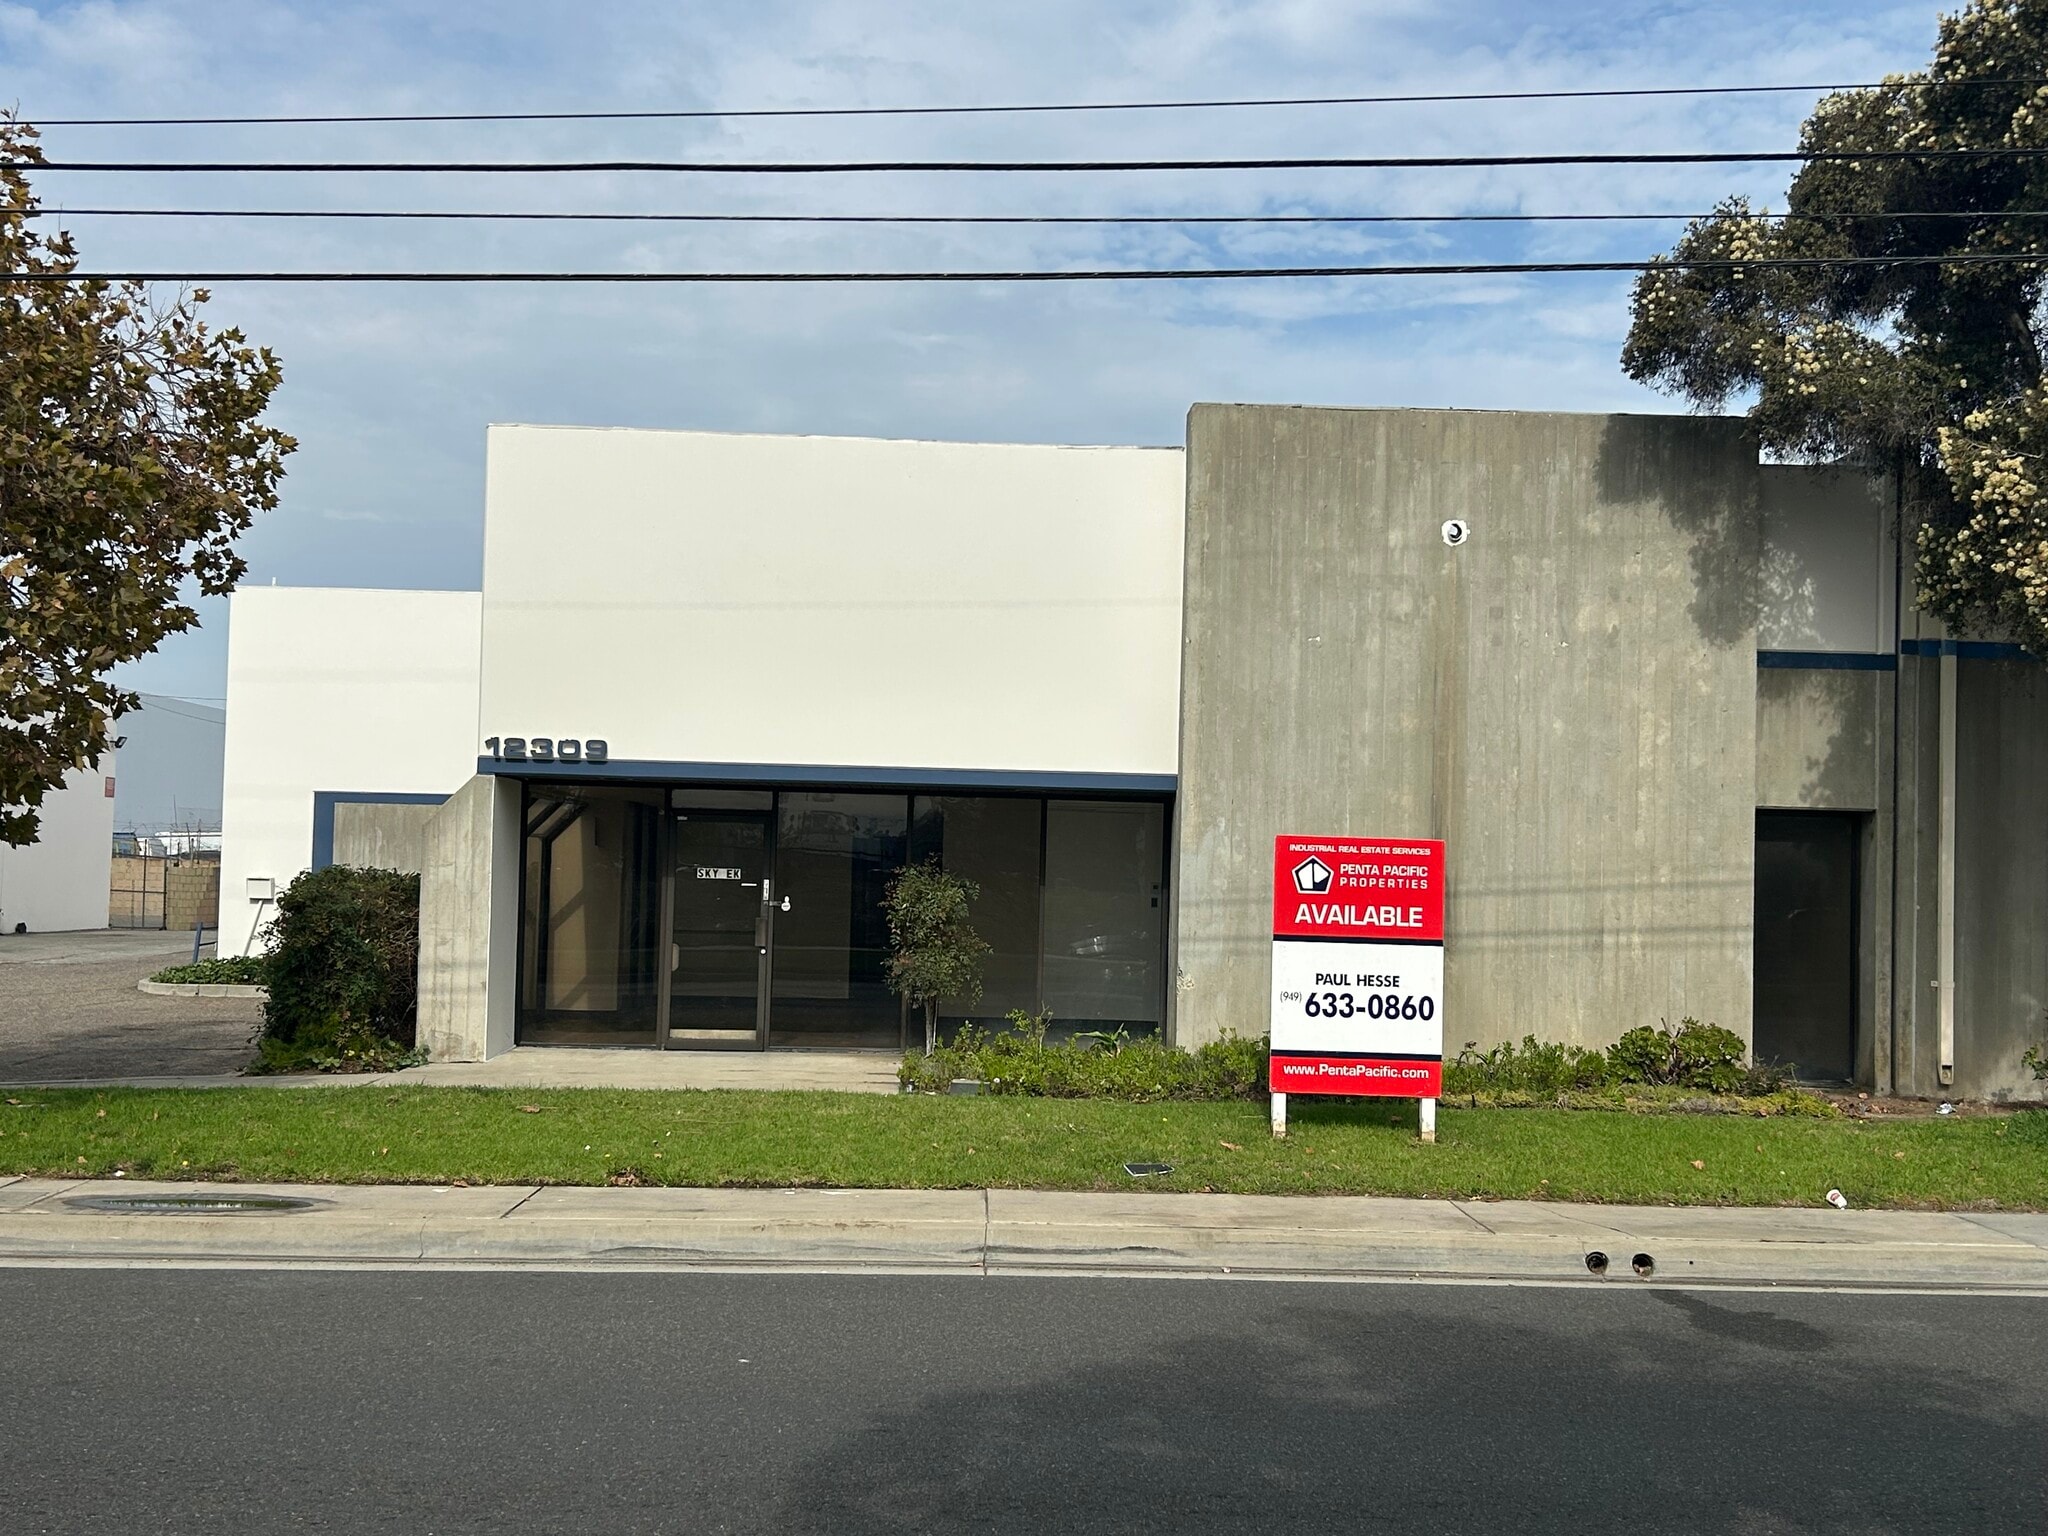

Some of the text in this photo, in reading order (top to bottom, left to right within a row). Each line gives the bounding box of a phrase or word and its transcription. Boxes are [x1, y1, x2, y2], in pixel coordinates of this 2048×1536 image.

[485, 737, 608, 764] 12309
[1289, 844, 1431, 856] INDUSTRIAL REAL ESTATE SERVICES
[698, 868, 720, 878] SKY
[1340, 863, 1429, 877] PENTA PACIFIC
[1340, 877, 1428, 890] PROPERTIES
[1294, 903, 1424, 928] AVAILABLE
[1315, 973, 1400, 988] PAUL HESSE
[1279, 991, 1435, 1021] (949) 633-0860
[1283, 1063, 1430, 1079] www.PentaPacific.com
